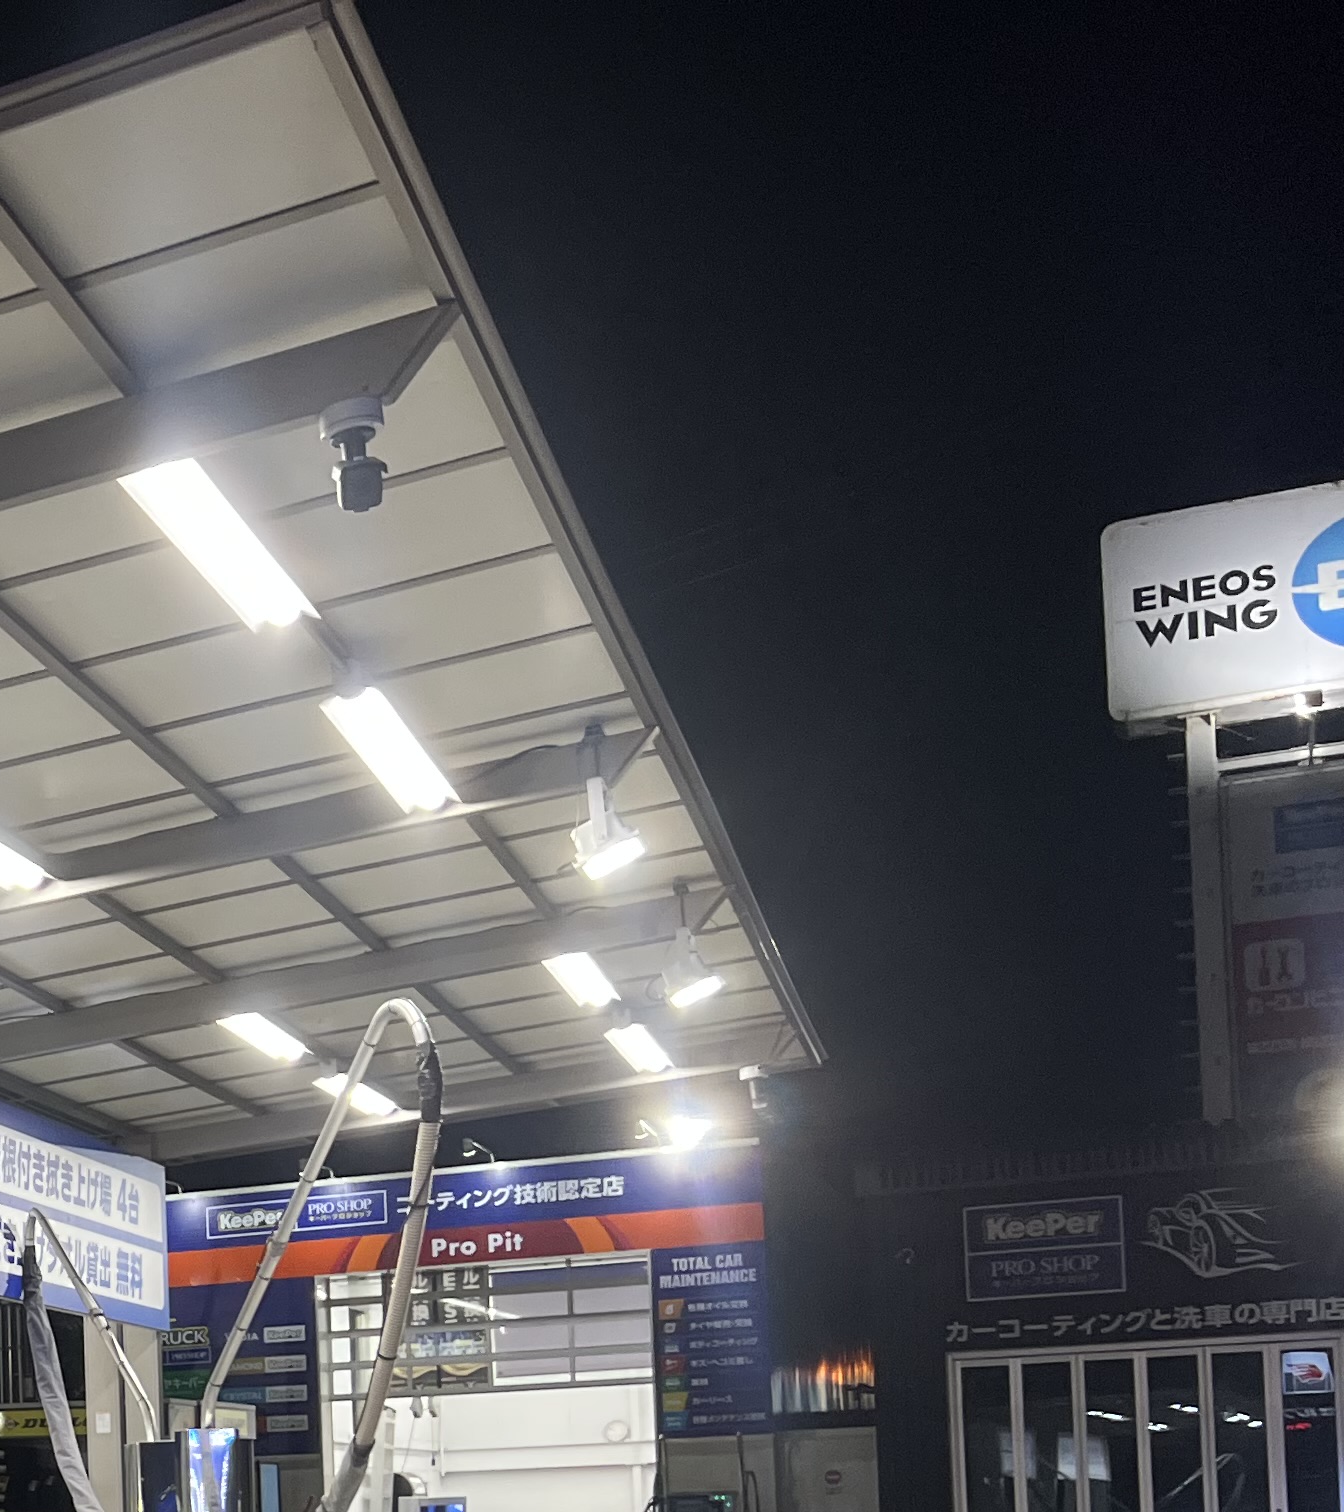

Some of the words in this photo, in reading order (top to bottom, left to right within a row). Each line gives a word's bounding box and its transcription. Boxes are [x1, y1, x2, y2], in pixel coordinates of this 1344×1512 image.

[1133, 564, 1276, 613] ENEOS
[1136, 599, 1278, 648] WING
[117, 1178, 140, 1225] 4台
[308, 1202, 335, 1215] PRO
[337, 1198, 372, 1213] SHOP
[986, 1211, 1100, 1241] KeePer
[431, 1237, 477, 1258] Pro
[487, 1231, 524, 1253] Pit
[671, 1256, 712, 1272] TOTAL
[715, 1253, 743, 1268] CAR
[991, 1258, 1036, 1278] PRO
[1040, 1254, 1101, 1274] SHOP
[659, 1268, 757, 1289] MAINTENANCE
